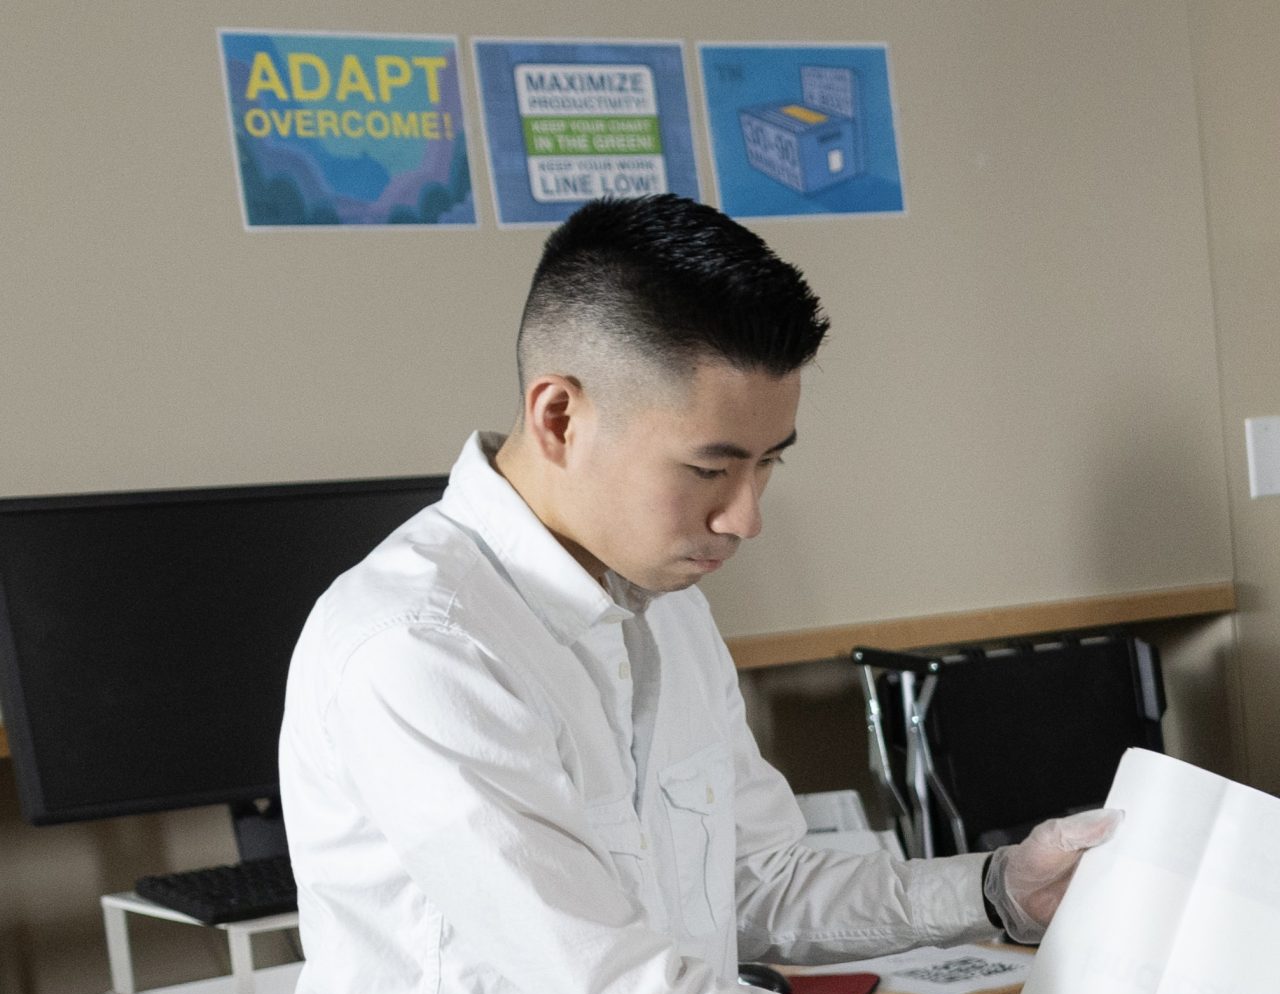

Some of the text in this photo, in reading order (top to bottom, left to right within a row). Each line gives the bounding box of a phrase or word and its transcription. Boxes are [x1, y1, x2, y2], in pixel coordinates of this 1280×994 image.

[245, 52, 447, 104] ADAPT
[526, 72, 644, 92] MAXIMIZE
[244, 108, 455, 141] OVERCOME!
[531, 119, 566, 132] KEEP
[533, 134, 553, 149] IN
[558, 134, 590, 149] THE
[541, 175, 593, 195] LINE
